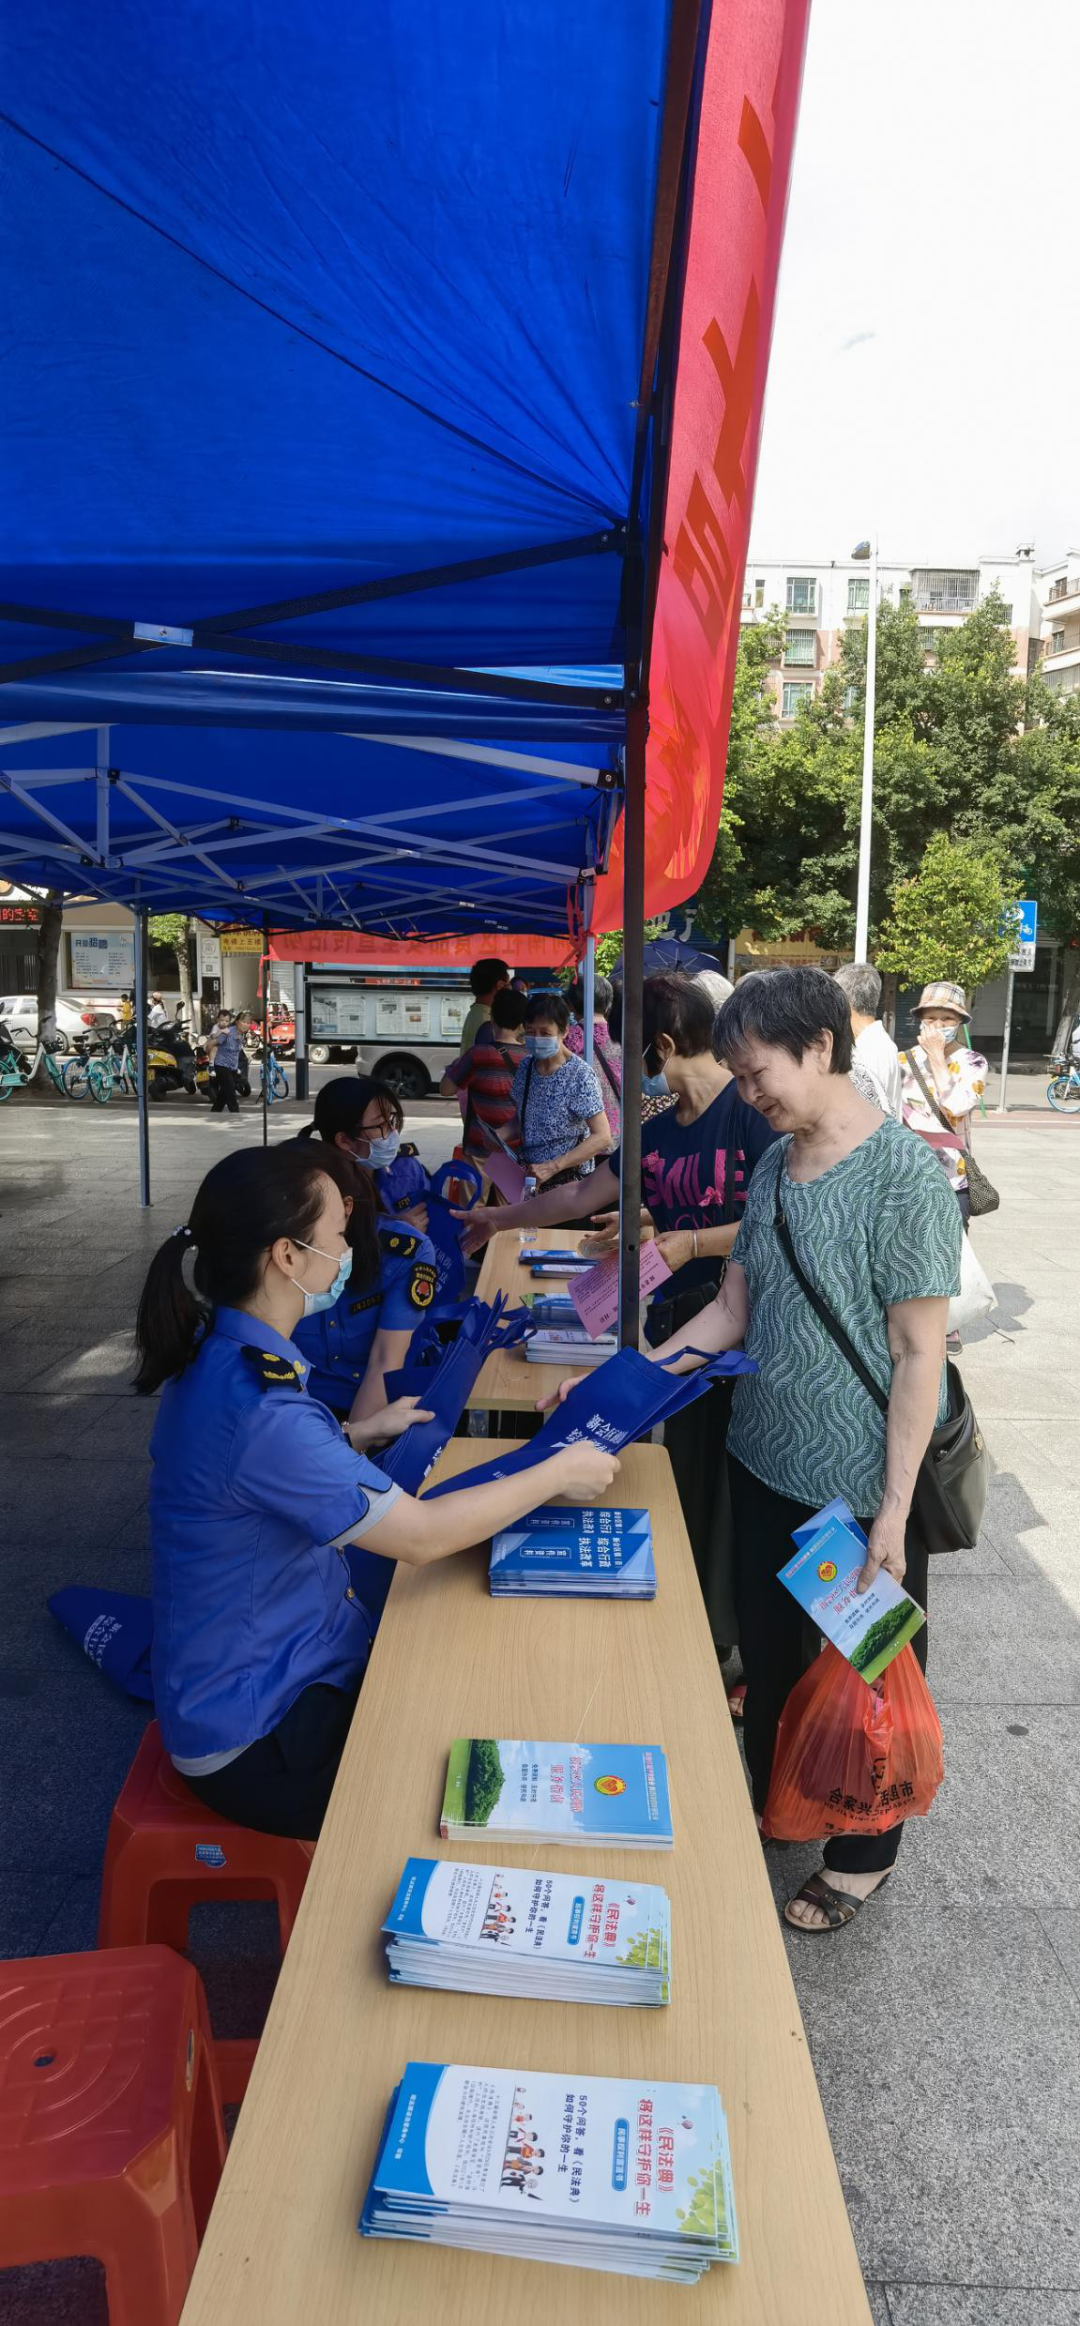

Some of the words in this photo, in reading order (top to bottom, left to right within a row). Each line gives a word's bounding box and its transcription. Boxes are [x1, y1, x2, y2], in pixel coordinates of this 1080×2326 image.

[524, 1549, 567, 1557] 宣传资料
[579, 1537, 593, 1567] 执法改革
[597, 1537, 612, 1568] 综合行政
[524, 1878, 542, 1934] 如何守护你的一生
[583, 1883, 606, 1959] 将这样守护你一生
[601, 1902, 620, 1948] 《民法典》
[557, 2093, 574, 2174] 如何守护你的一生
[635, 2098, 653, 2217] 将这样守护你一生
[656, 2126, 675, 2193] 《民法典》
